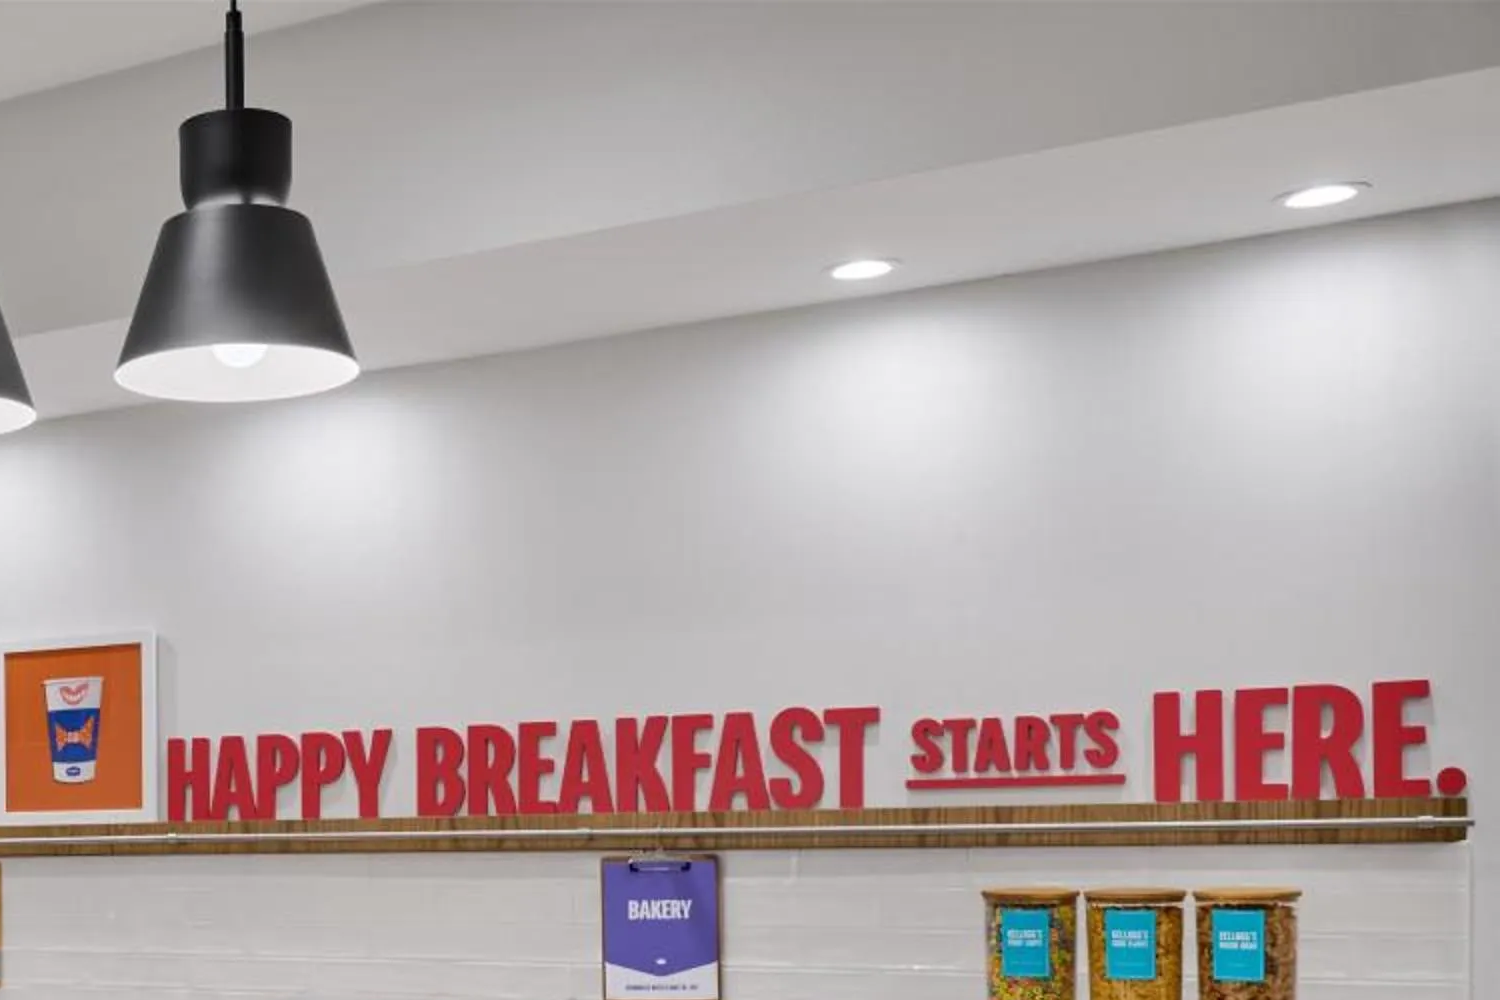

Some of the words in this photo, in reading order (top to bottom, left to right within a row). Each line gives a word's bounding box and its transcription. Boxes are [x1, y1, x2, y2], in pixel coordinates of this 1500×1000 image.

[167, 728, 393, 822] HAPPY
[416, 706, 880, 818] BREAKFAST
[910, 711, 1120, 773] STARTS
[1153, 679, 1468, 803] HERE.
[627, 899, 693, 921] BAKERY
